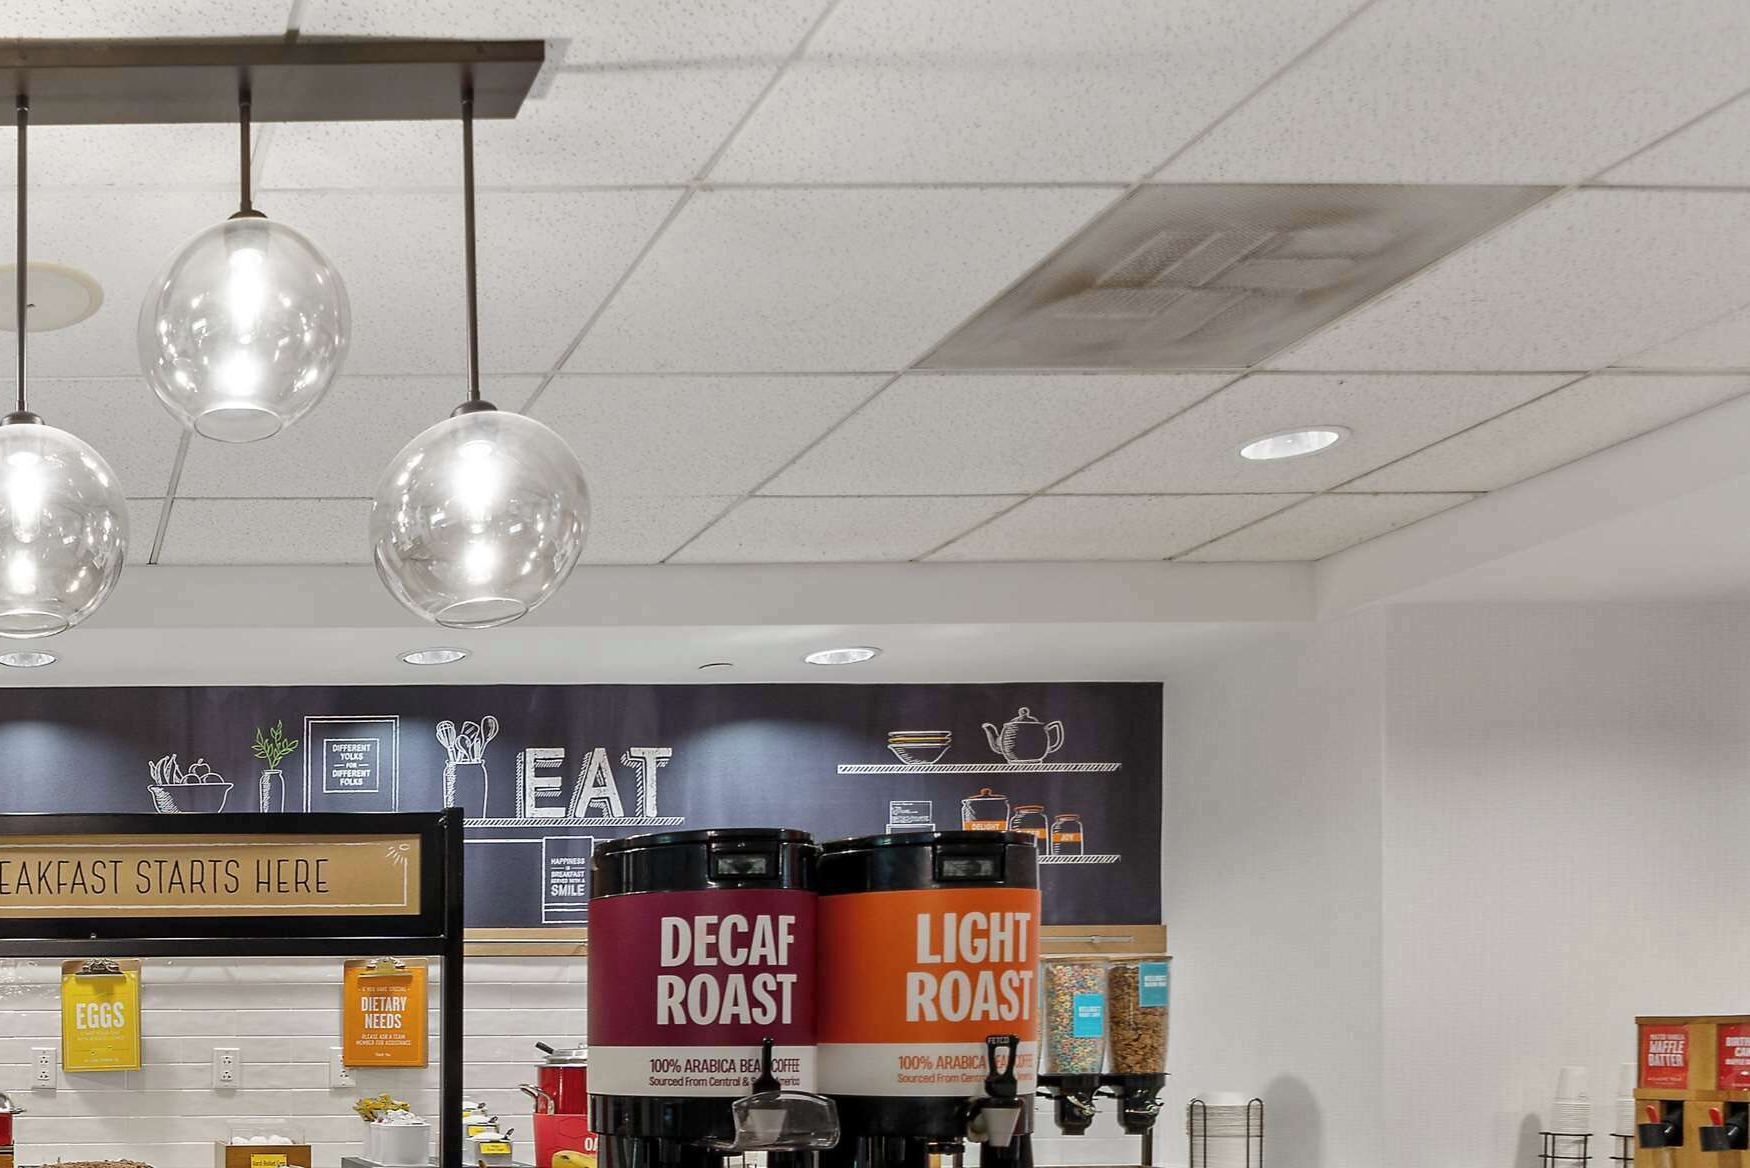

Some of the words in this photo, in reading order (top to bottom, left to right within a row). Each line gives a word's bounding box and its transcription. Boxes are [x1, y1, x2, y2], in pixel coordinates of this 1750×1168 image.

[332, 744, 371, 752] DIFFERENT
[340, 753, 364, 761] YOLKS
[332, 769, 371, 778] DIFFERENT
[340, 778, 364, 786] FOLKS
[515, 747, 673, 818] EAT
[550, 857, 586, 865] HAPPINESS
[135, 859, 240, 895] STARTS
[256, 858, 330, 893] HERE
[550, 870, 585, 878] BREAKFAST
[550, 884, 586, 897] SMILE
[660, 914, 796, 967] DECAF
[916, 911, 1031, 964] LIGHT
[656, 972, 798, 1026] ROAST
[905, 969, 1033, 1022] ROAST
[361, 996, 407, 1012] DIETARY
[76, 1001, 126, 1029] EGGS
[364, 1013, 402, 1029] NEEDS
[1649, 1040, 1686, 1054] WAFFLE
[649, 1058, 682, 1074] 100%
[684, 1058, 737, 1074] ARABICA
[740, 1058, 762, 1073] BEA
[771, 1058, 800, 1073] COFFEE
[898, 1055, 932, 1070] 100%
[937, 1055, 988, 1070] ARABICA
[1648, 1053, 1685, 1067] BATTER
[649, 1076, 683, 1087] Sourced
[685, 1076, 707, 1087] From
[709, 1076, 740, 1087] Central
[742, 1076, 749, 1087] &
[897, 1073, 935, 1084] Sourced
[937, 1073, 959, 1083] From
